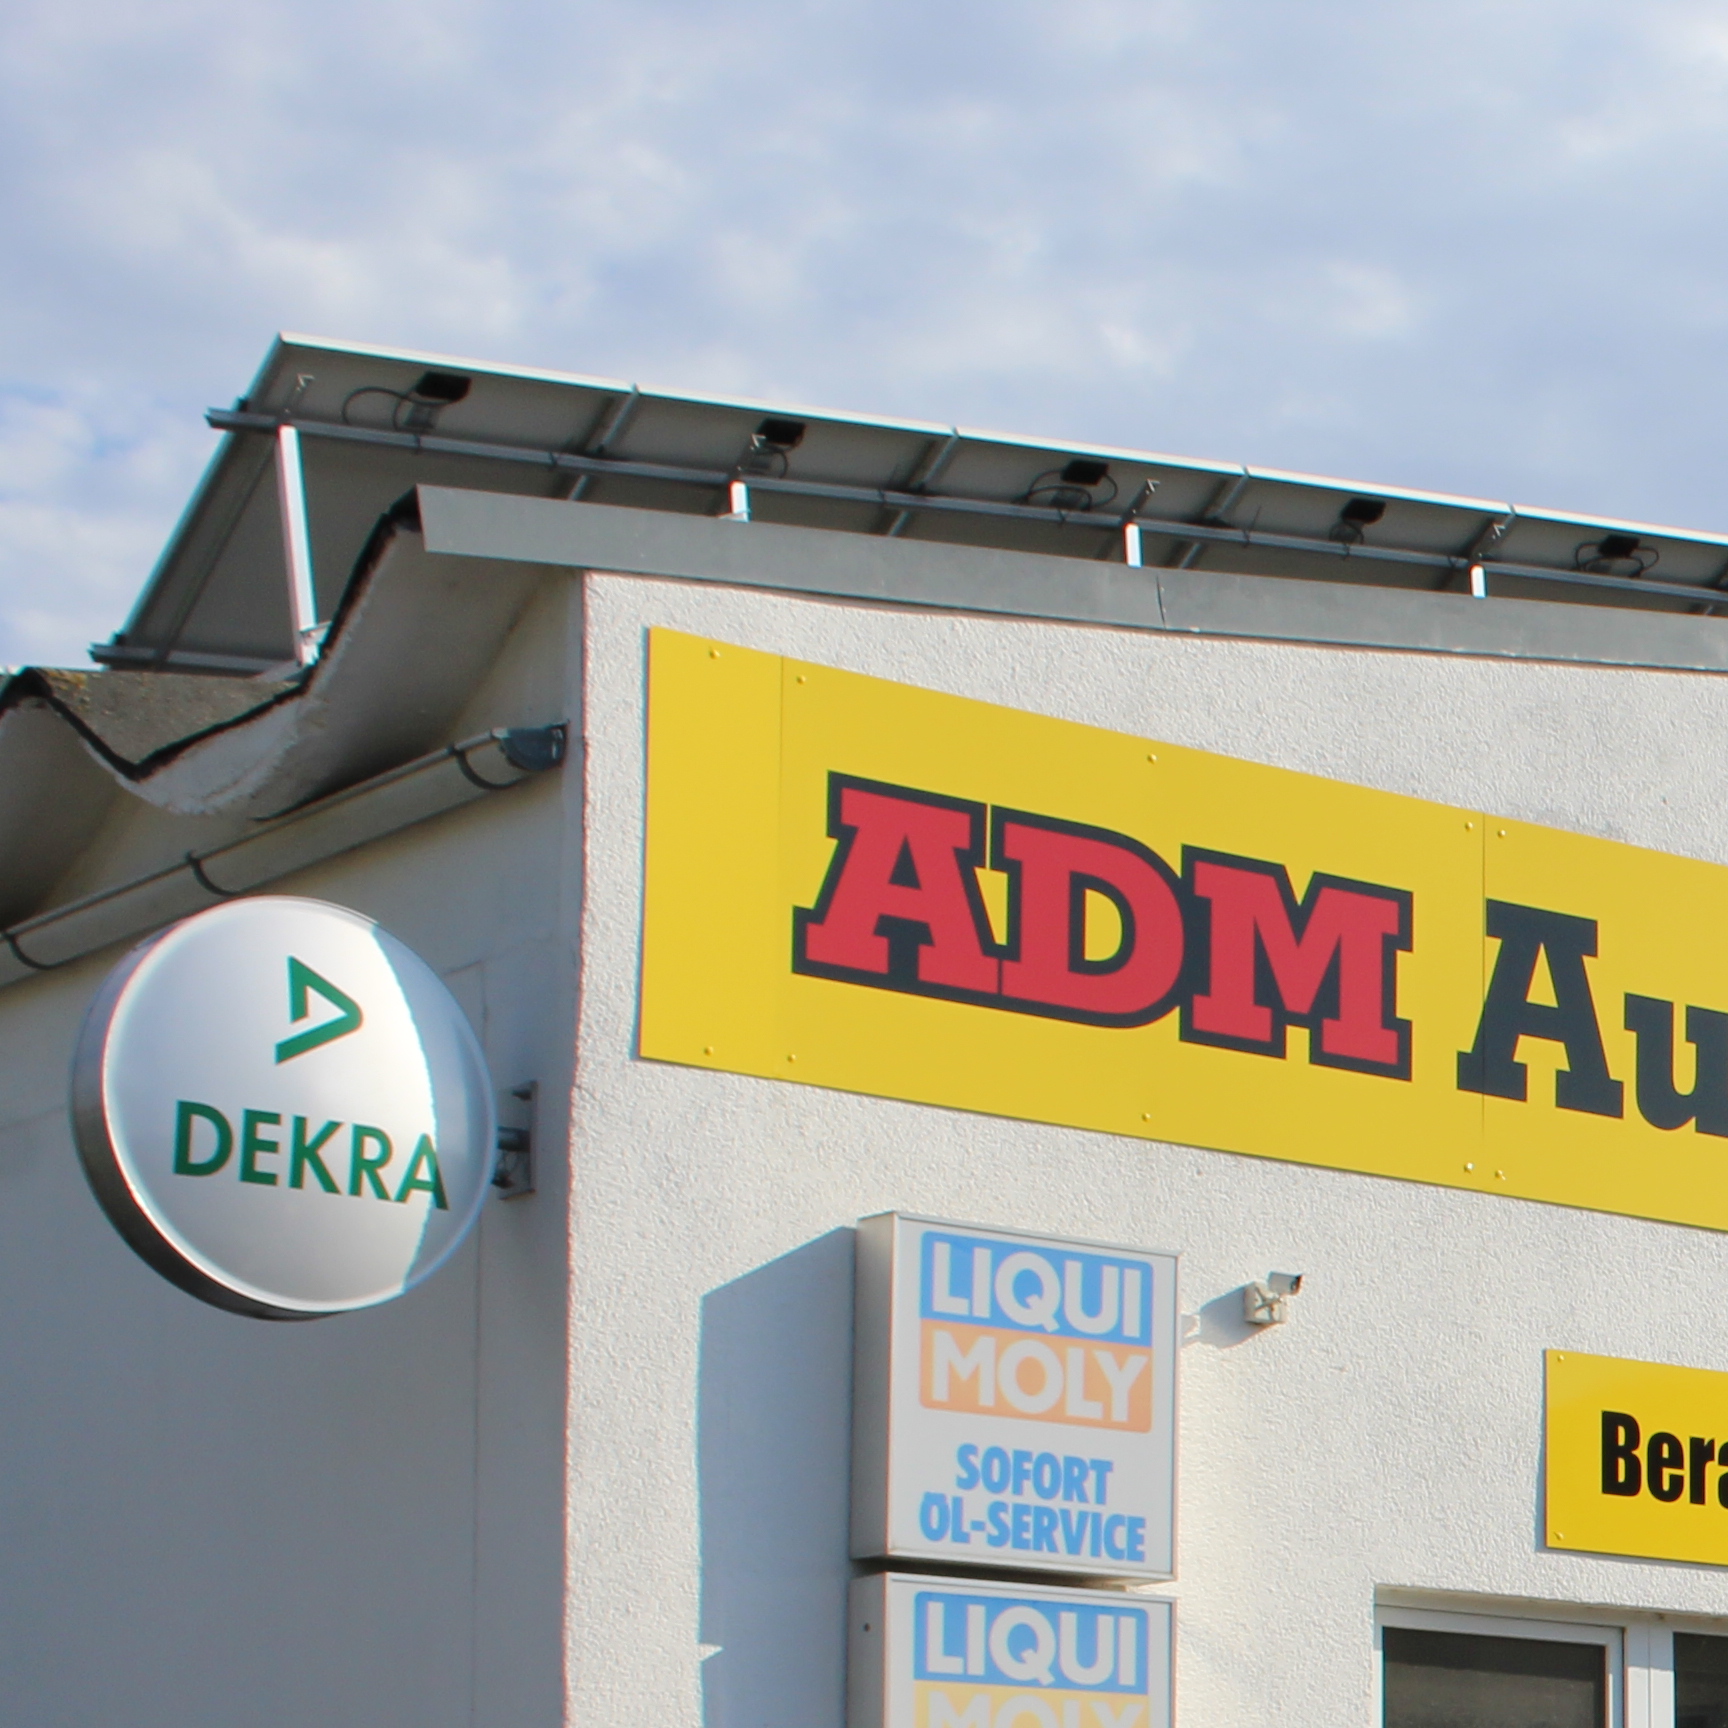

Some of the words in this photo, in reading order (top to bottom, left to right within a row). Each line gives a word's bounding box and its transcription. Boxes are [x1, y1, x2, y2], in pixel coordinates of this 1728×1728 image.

[792, 771, 1413, 1080] ADM
[173, 1100, 449, 1211] DEKRA
[932, 1243, 1143, 1337] LIQUI
[932, 1331, 1148, 1432] MOLY
[956, 1445, 1113, 1505] SOFORT
[920, 1492, 1146, 1562] ÖL-SERVICE
[925, 1602, 1137, 1687] LIQUI
